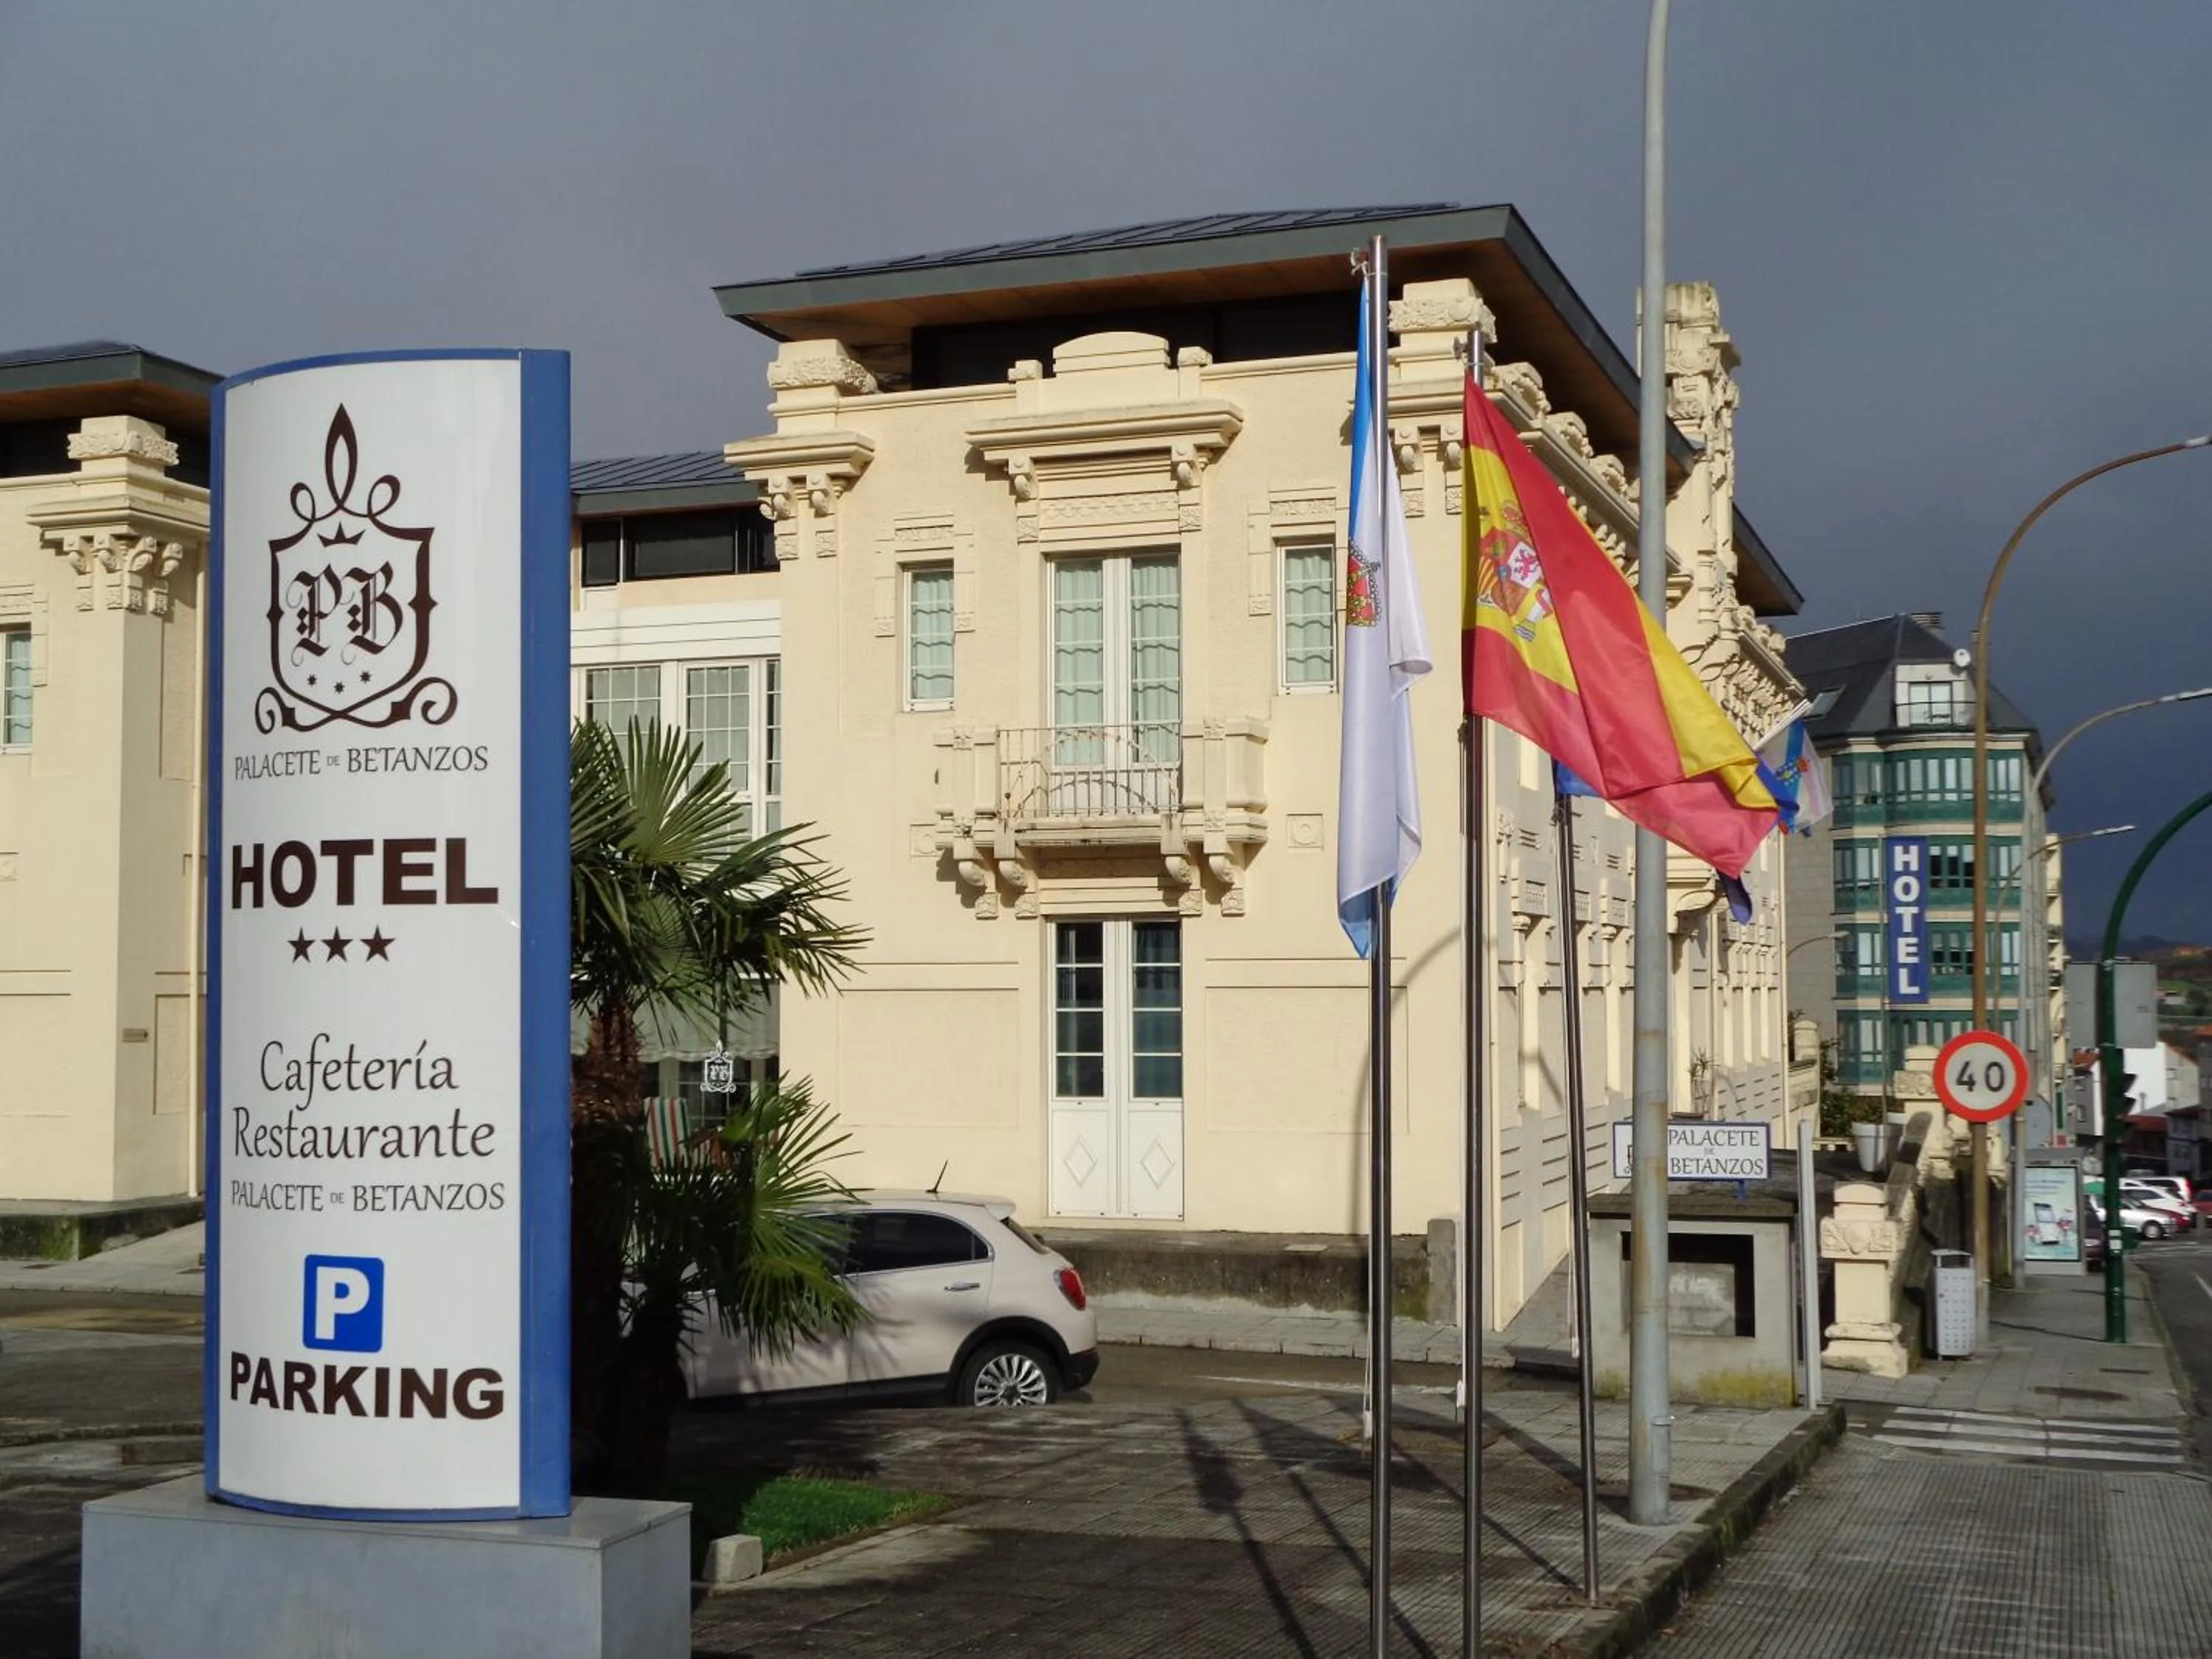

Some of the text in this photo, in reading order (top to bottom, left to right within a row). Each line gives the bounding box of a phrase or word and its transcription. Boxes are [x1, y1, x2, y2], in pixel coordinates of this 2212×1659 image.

[234, 745, 488, 780] PALACETE DE BETANZOS
[232, 838, 498, 909] HOTEL
[1893, 845, 1920, 995] HOTEL
[260, 1033, 459, 1111] Cafetería
[1955, 1060, 2006, 1093] 40
[233, 1106, 495, 1158] Restaurante
[1669, 1129, 1759, 1147] PALACETE
[1671, 1158, 1764, 1175] BETANZOS
[231, 1180, 504, 1212] PALACETE DE BETANZOS
[315, 1266, 370, 1340] P
[231, 1351, 504, 1420] PARKING
